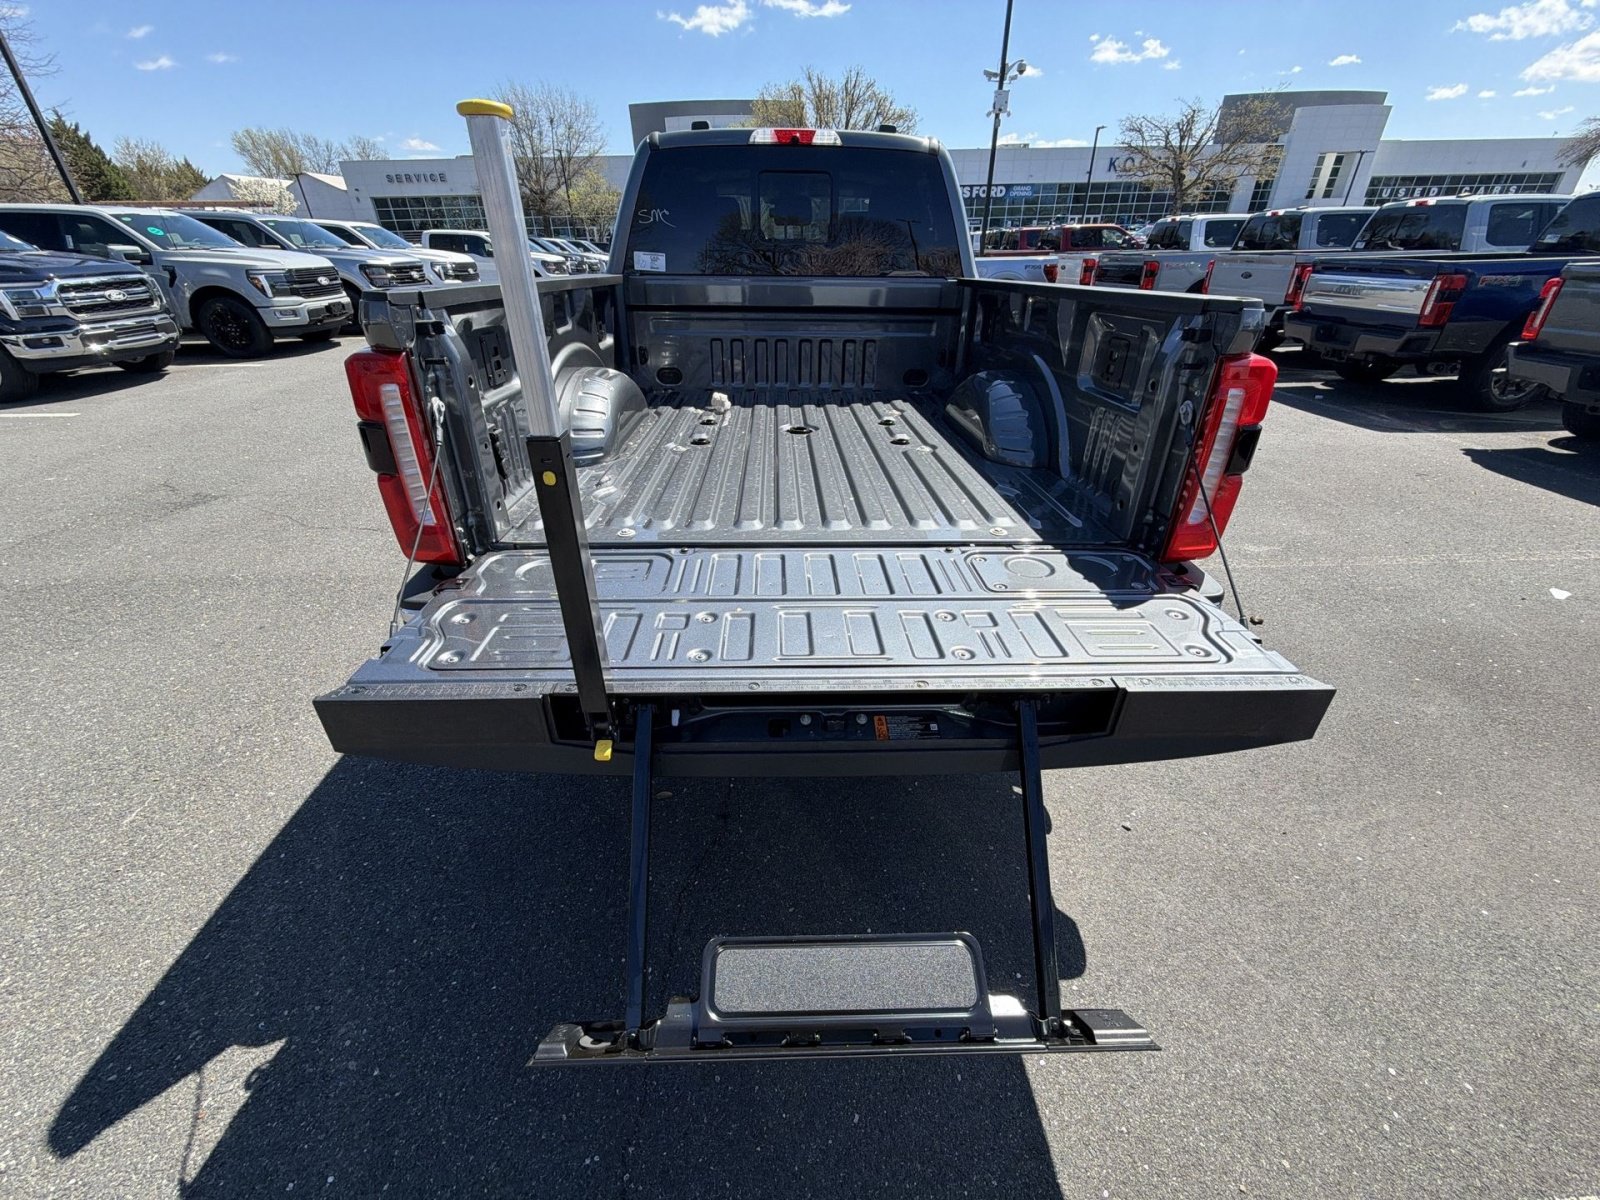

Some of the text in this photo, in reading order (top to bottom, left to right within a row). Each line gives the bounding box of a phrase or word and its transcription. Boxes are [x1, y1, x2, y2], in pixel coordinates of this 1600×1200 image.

[385, 172, 448, 183] SERVICE
[972, 185, 1006, 198] FORD
[1382, 186, 1517, 197] USED CARS
